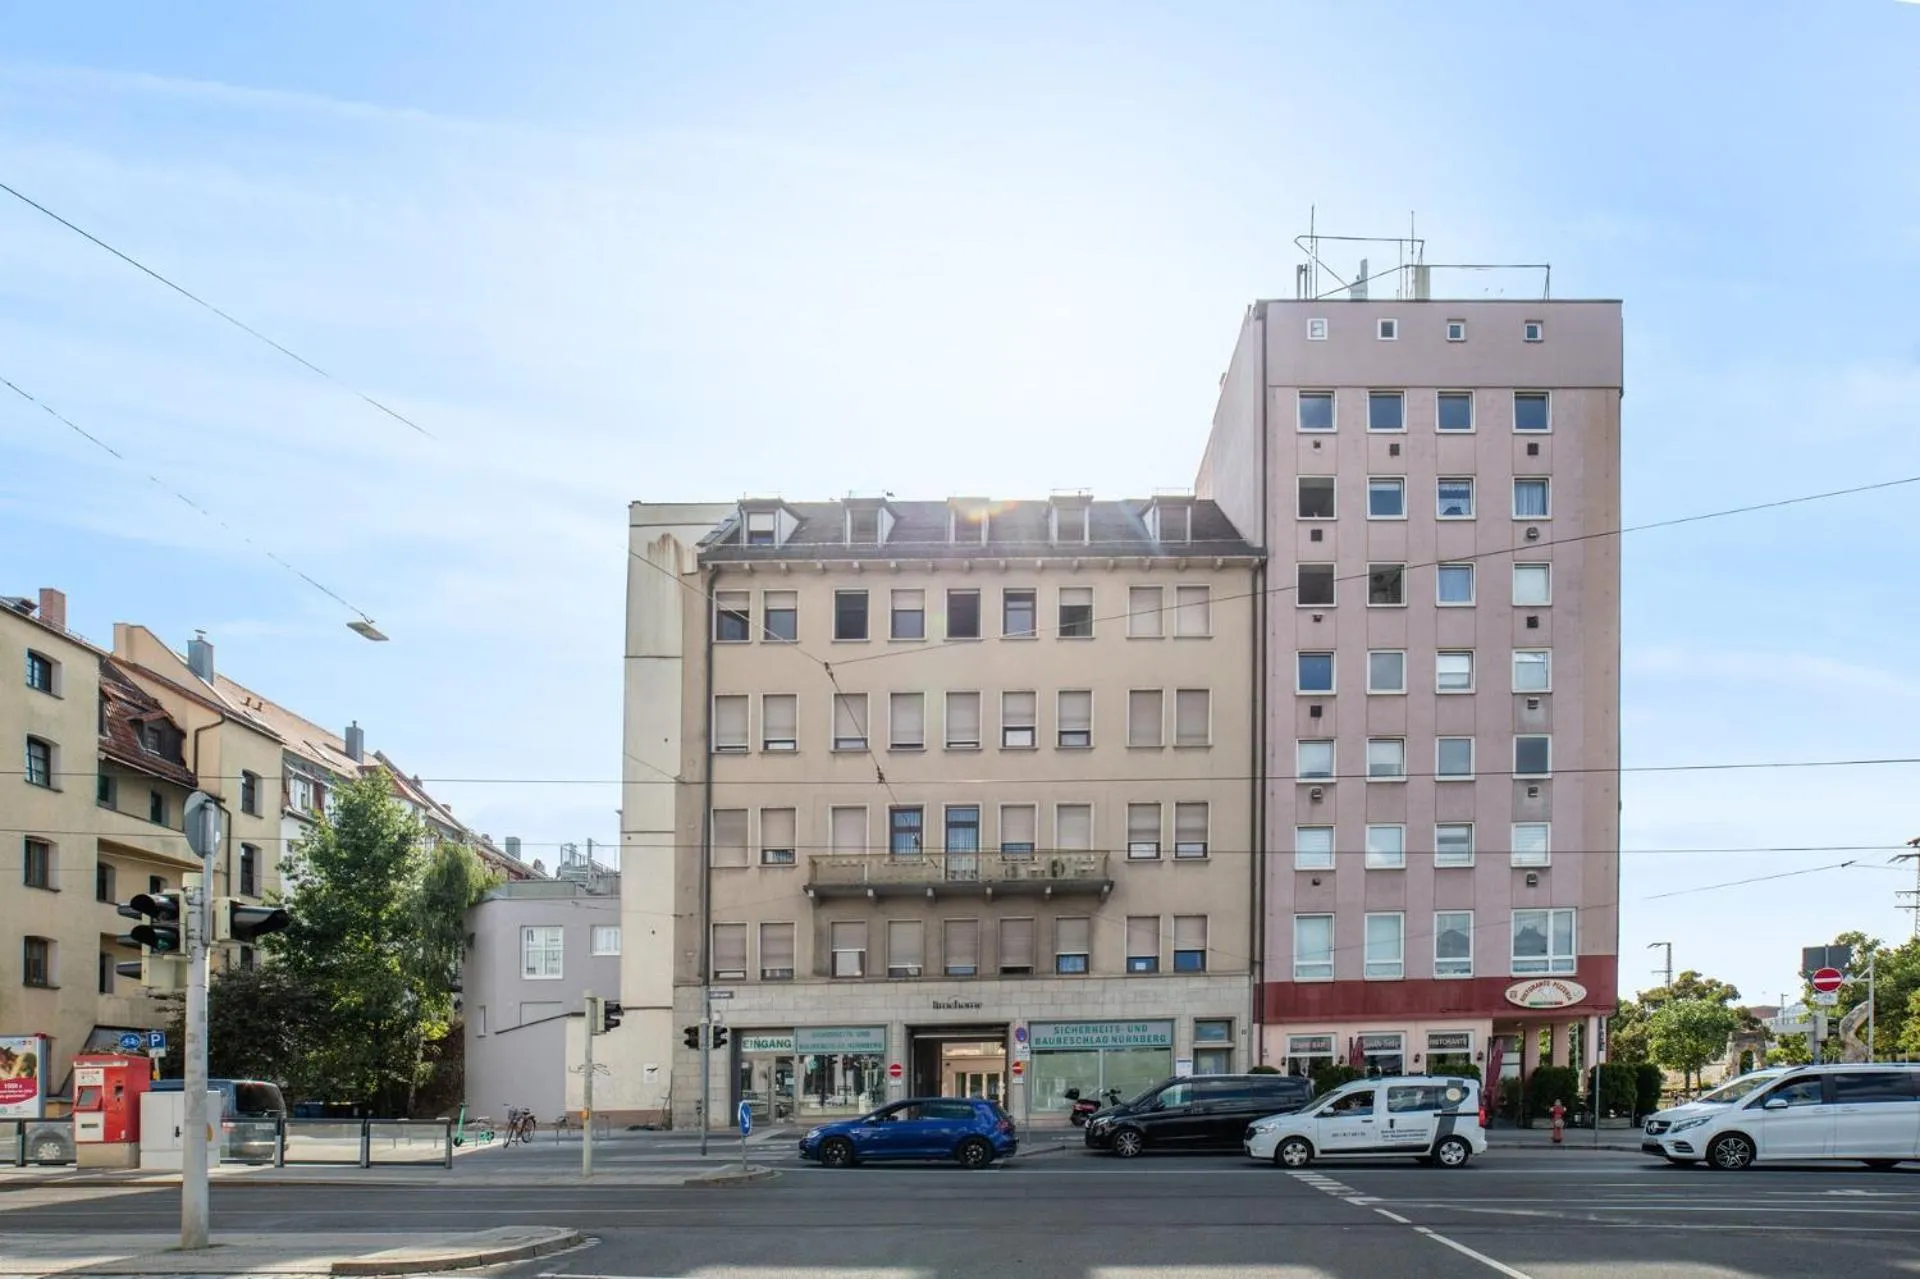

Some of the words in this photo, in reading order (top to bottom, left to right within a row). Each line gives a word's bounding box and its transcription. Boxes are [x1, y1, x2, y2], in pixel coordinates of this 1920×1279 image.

[1127, 1023, 1148, 1033] UND
[151, 1034, 161, 1047] P
[742, 1039, 792, 1049] EINGANG
